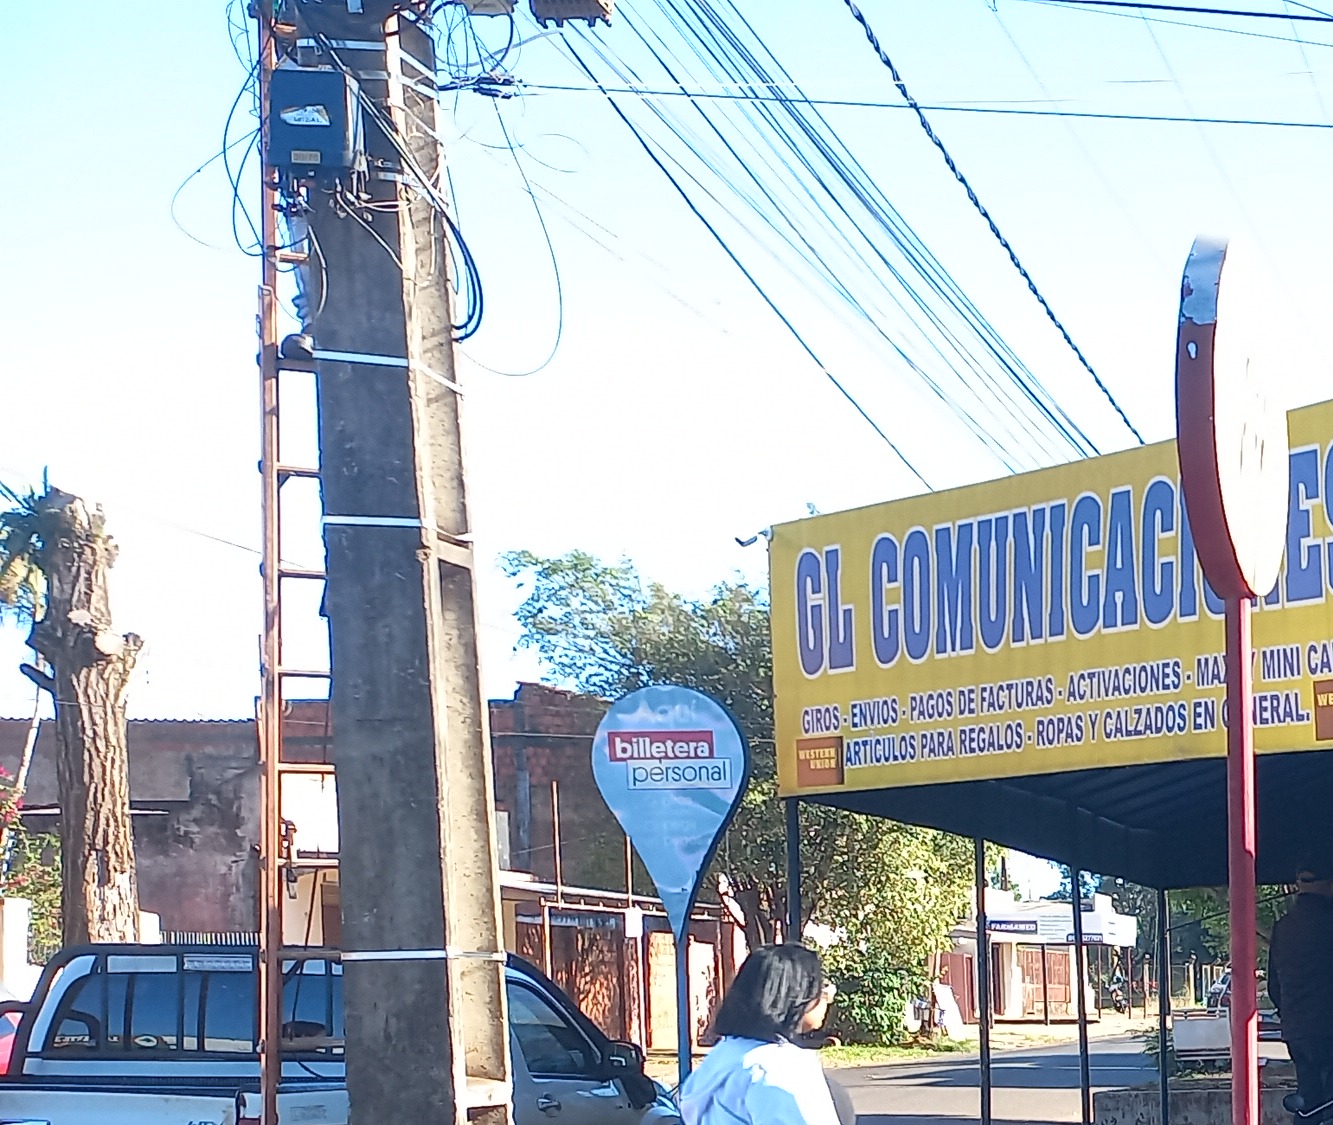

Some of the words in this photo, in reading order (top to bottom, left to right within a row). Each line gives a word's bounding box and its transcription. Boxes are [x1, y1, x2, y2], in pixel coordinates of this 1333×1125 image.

[796, 547, 855, 676] GL
[802, 708, 840, 734] GIROS
[851, 699, 898, 728] ENVIOS
[910, 691, 954, 722] PAGOS
[958, 688, 976, 716] DE
[980, 677, 1054, 713] FACTURAS
[1068, 660, 1181, 701] ACTIVACIONES
[1262, 646, 1302, 680] MINI
[921, 730, 955, 759] PARA
[960, 721, 1023, 755] REGALOS
[1036, 714, 1083, 746] ROPAS
[1089, 711, 1099, 741] Y
[1103, 702, 1187, 740] CALZADOS
[1193, 699, 1215, 731] EN
[614, 737, 710, 758] billetera
[799, 747, 836, 760] WESTERN
[632, 760, 727, 787] personal
[810, 757, 836, 769] UNION
